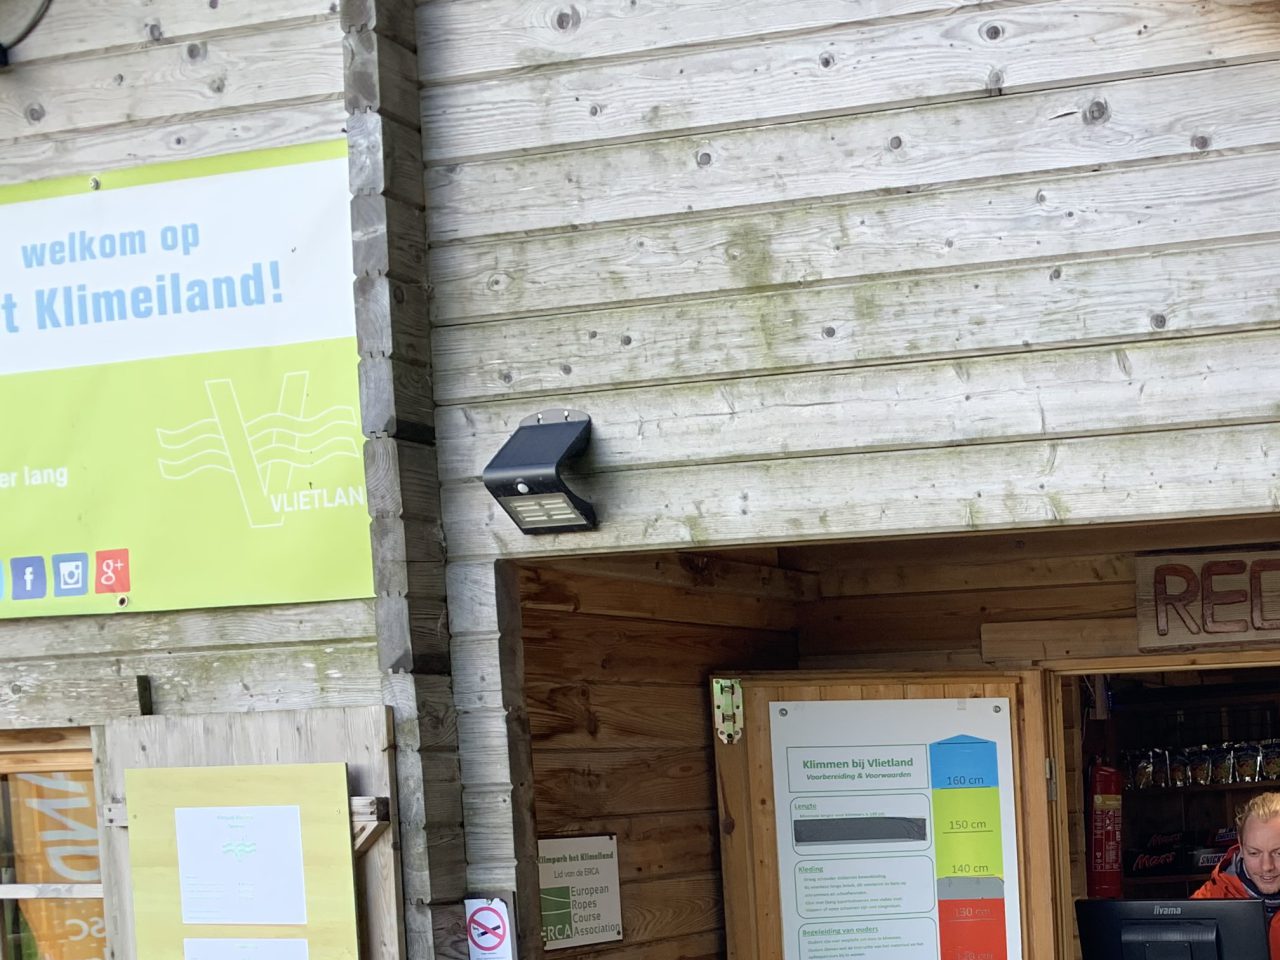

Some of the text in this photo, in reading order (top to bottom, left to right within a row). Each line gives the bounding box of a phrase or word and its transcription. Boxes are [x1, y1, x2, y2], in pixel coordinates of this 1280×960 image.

[21, 222, 200, 269] welkom op
[35, 260, 283, 330] Klimeiland!
[24, 465, 69, 488] lang
[802, 757, 914, 770] Klimmen bij Vlietland
[806, 772, 856, 781] Voorbereiding
[865, 771, 912, 779] Voorwaarden
[947, 775, 984, 786] 160 cm
[794, 803, 817, 811] Lengte
[949, 819, 987, 830] 150 cm
[584, 867, 600, 877] ERCA
[798, 866, 824, 874] Kleding
[952, 864, 989, 874] 140 cm
[571, 885, 609, 897] European
[571, 899, 598, 911] Ropes
[572, 912, 601, 924] Course
[573, 922, 620, 937] Association
[802, 927, 841, 937] Begeleiding
